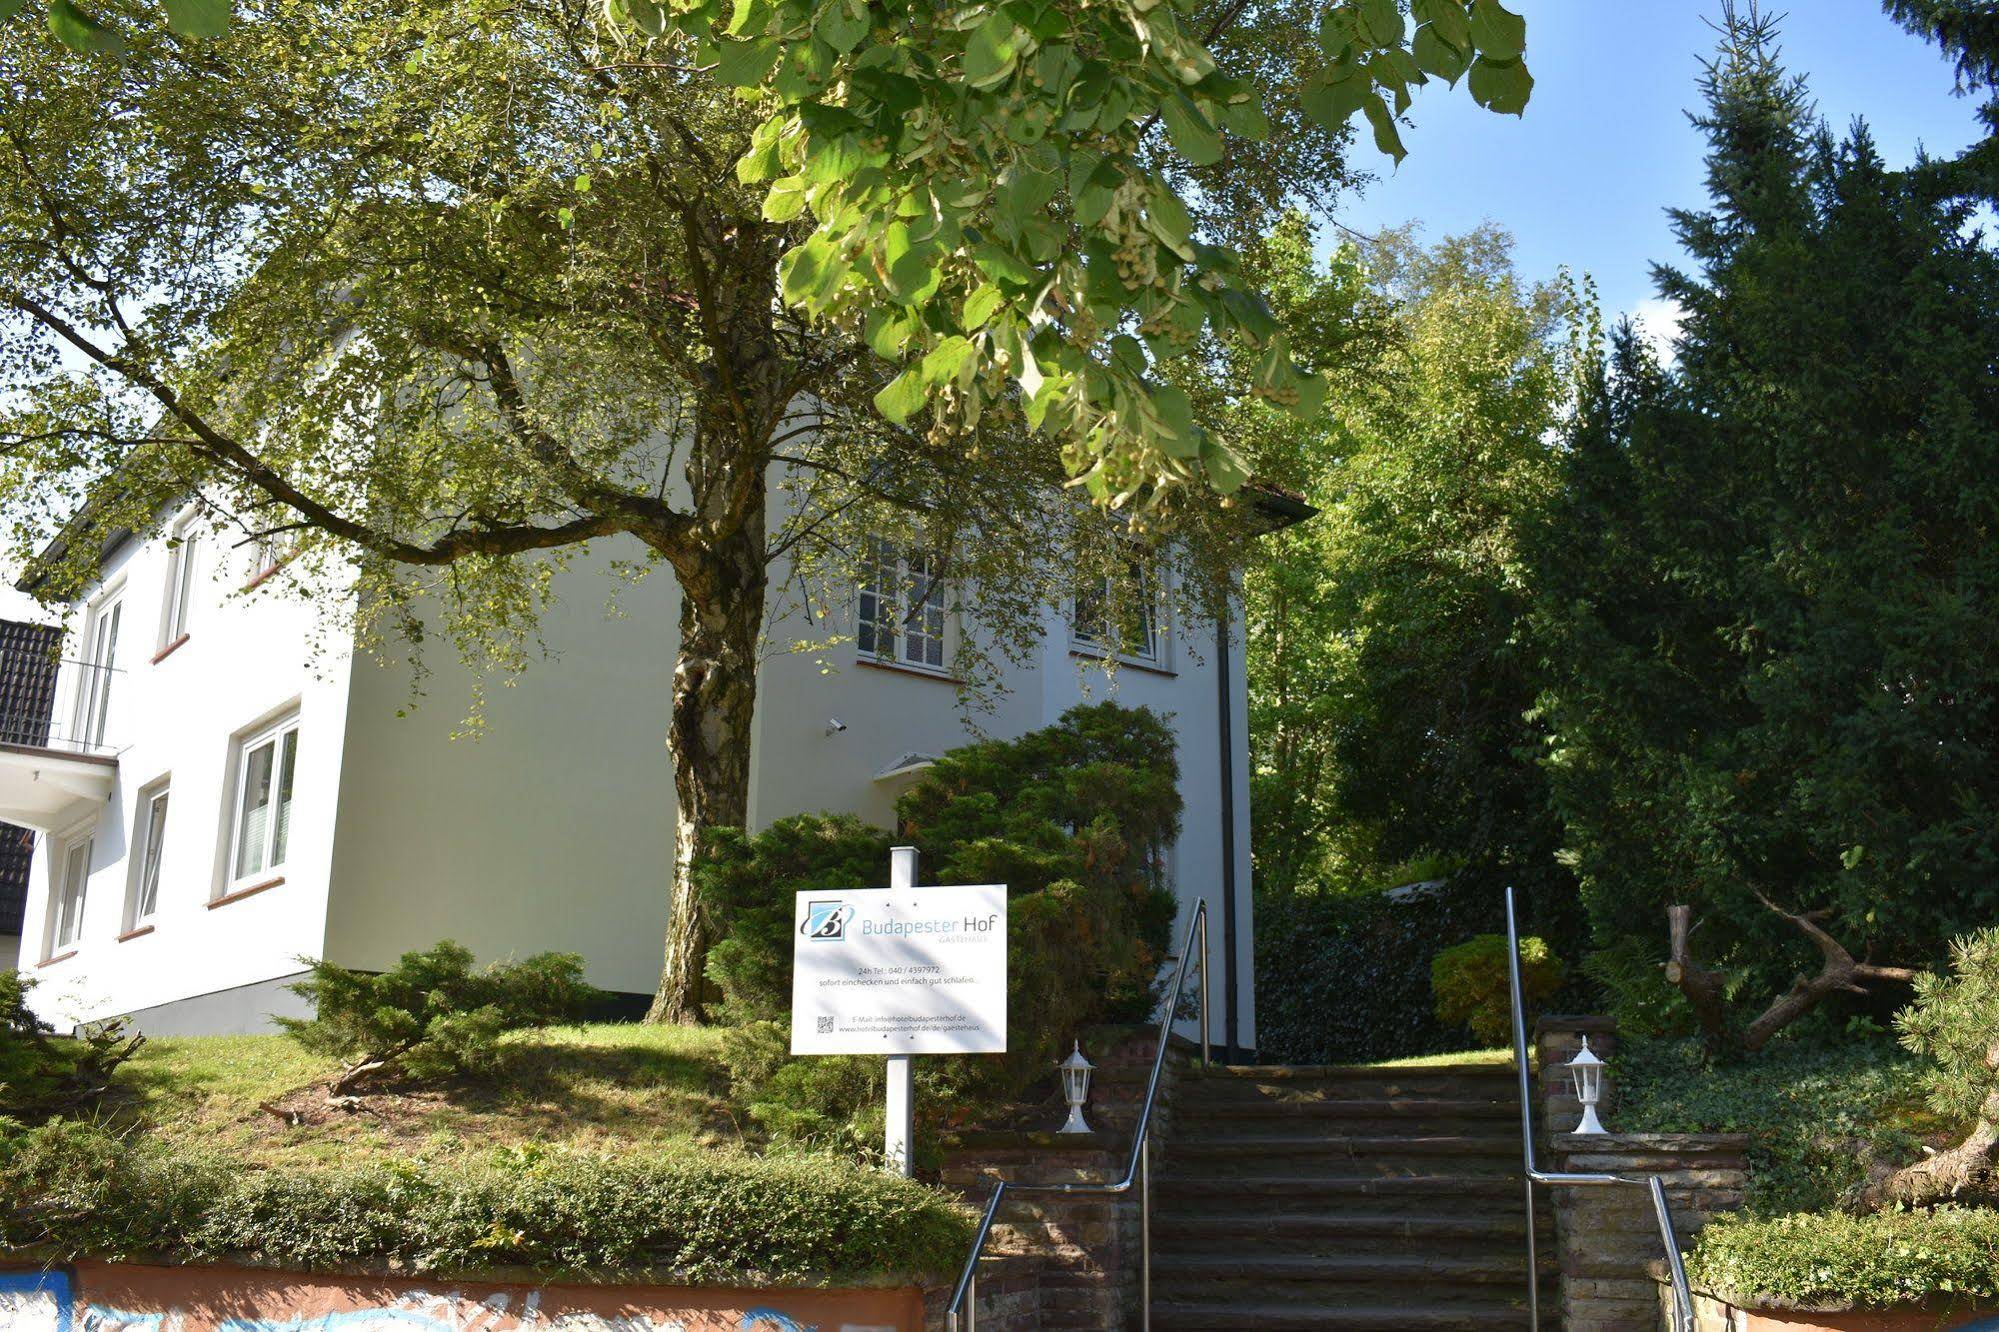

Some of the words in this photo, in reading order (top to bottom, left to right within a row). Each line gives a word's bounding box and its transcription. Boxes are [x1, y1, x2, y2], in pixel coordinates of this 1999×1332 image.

[862, 918, 959, 938] Budapester
[963, 914, 998, 932] Hof
[858, 967, 872, 975] 24h
[908, 966, 940, 974] 4397972
[819, 978, 841, 986] sofort
[842, 977, 883, 985] einchecken
[884, 977, 899, 985] und
[901, 976, 927, 985] einfach
[928, 977, 941, 986] gut
